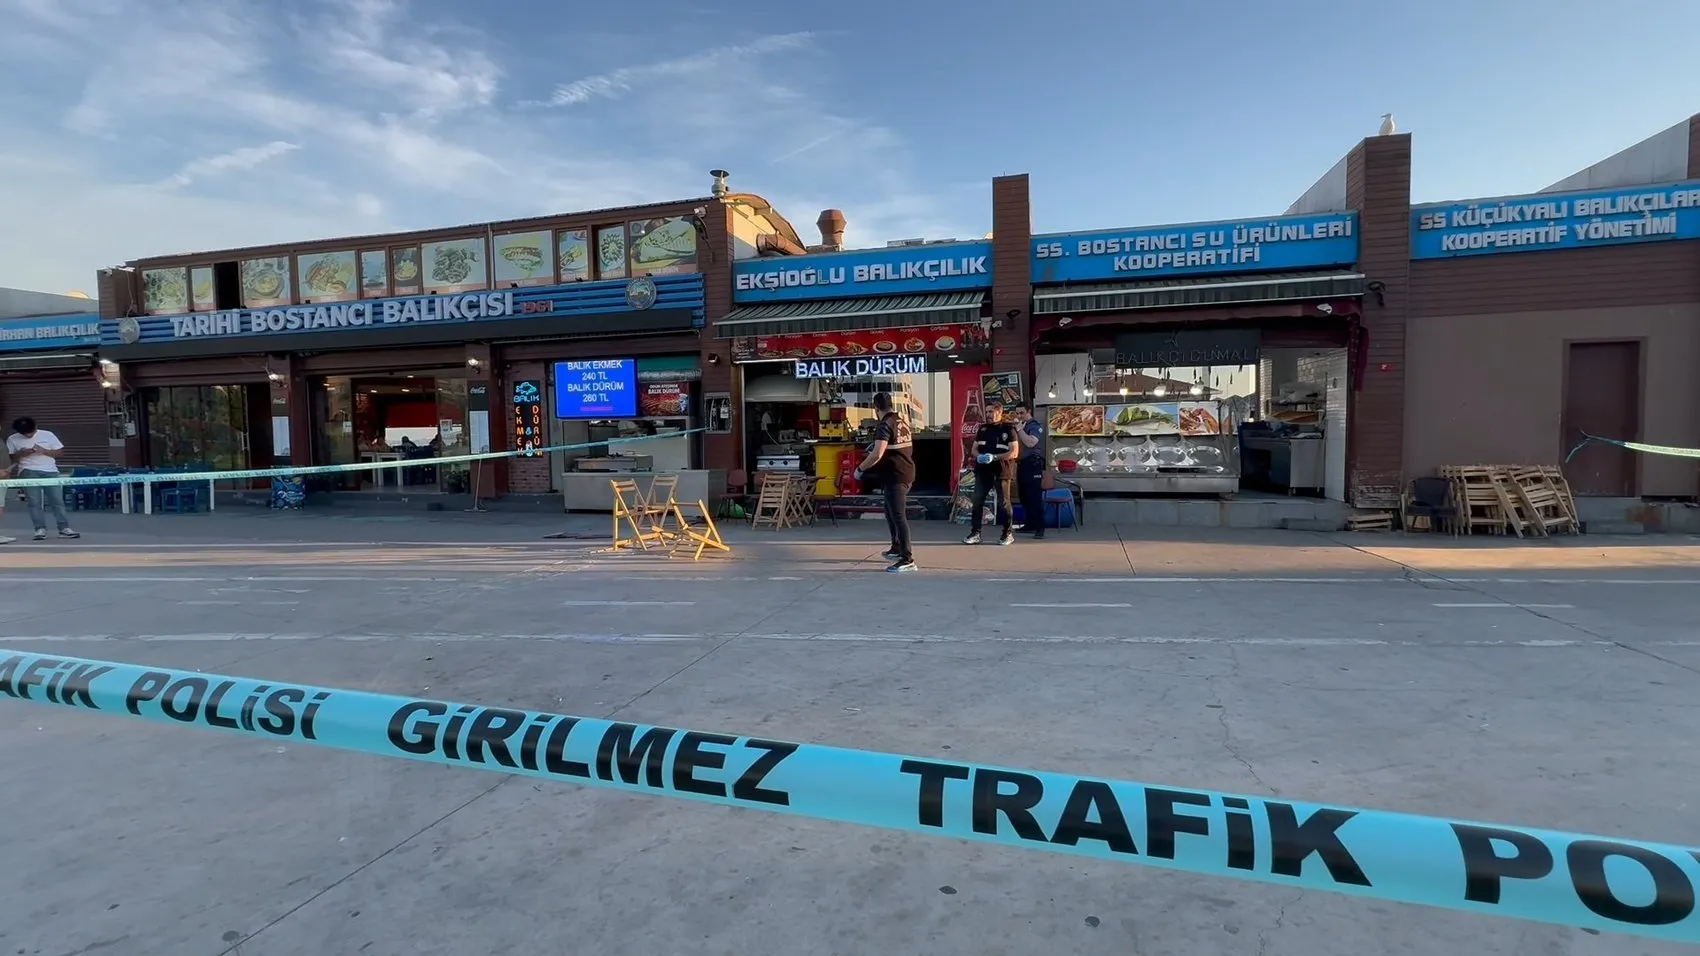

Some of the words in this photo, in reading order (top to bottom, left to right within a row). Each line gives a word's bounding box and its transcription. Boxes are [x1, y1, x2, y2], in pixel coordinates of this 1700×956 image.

[1419, 212, 1447, 230] SS
[1452, 201, 1568, 229] KÜÇÜKYALI
[1573, 188, 1700, 218] BALIKÇILAR
[1078, 236, 1187, 256] BOSTANCI
[1192, 231, 1225, 247] SU
[1232, 218, 1352, 245] ÜRÜNLERİ
[1442, 221, 1568, 251] KOOPERATİF
[1575, 211, 1677, 240] YÖNETİMİ
[1113, 243, 1261, 271] KOOPERATİFİ
[736, 265, 845, 291] EKŞİOĞLU
[853, 256, 987, 281] BALIKÇILIK
[170, 308, 241, 337] TARİHİ
[251, 303, 373, 332] BOSTANCI
[383, 292, 513, 323] BALIKÇISI
[36, 323, 99, 339] BALIKÇILIK
[567, 361, 592, 370] BALIK
[594, 360, 622, 369] EKMEK
[582, 372, 597, 380] 240
[598, 371, 608, 380] TL
[796, 360, 851, 378] BALIK
[856, 355, 925, 375] DÜRÜM
[514, 395, 540, 403] BALIK
[567, 383, 592, 392] BALIK
[593, 382, 624, 391] DÜRÜM
[599, 393, 609, 402] TL
[1448, 822, 1700, 926] PO
